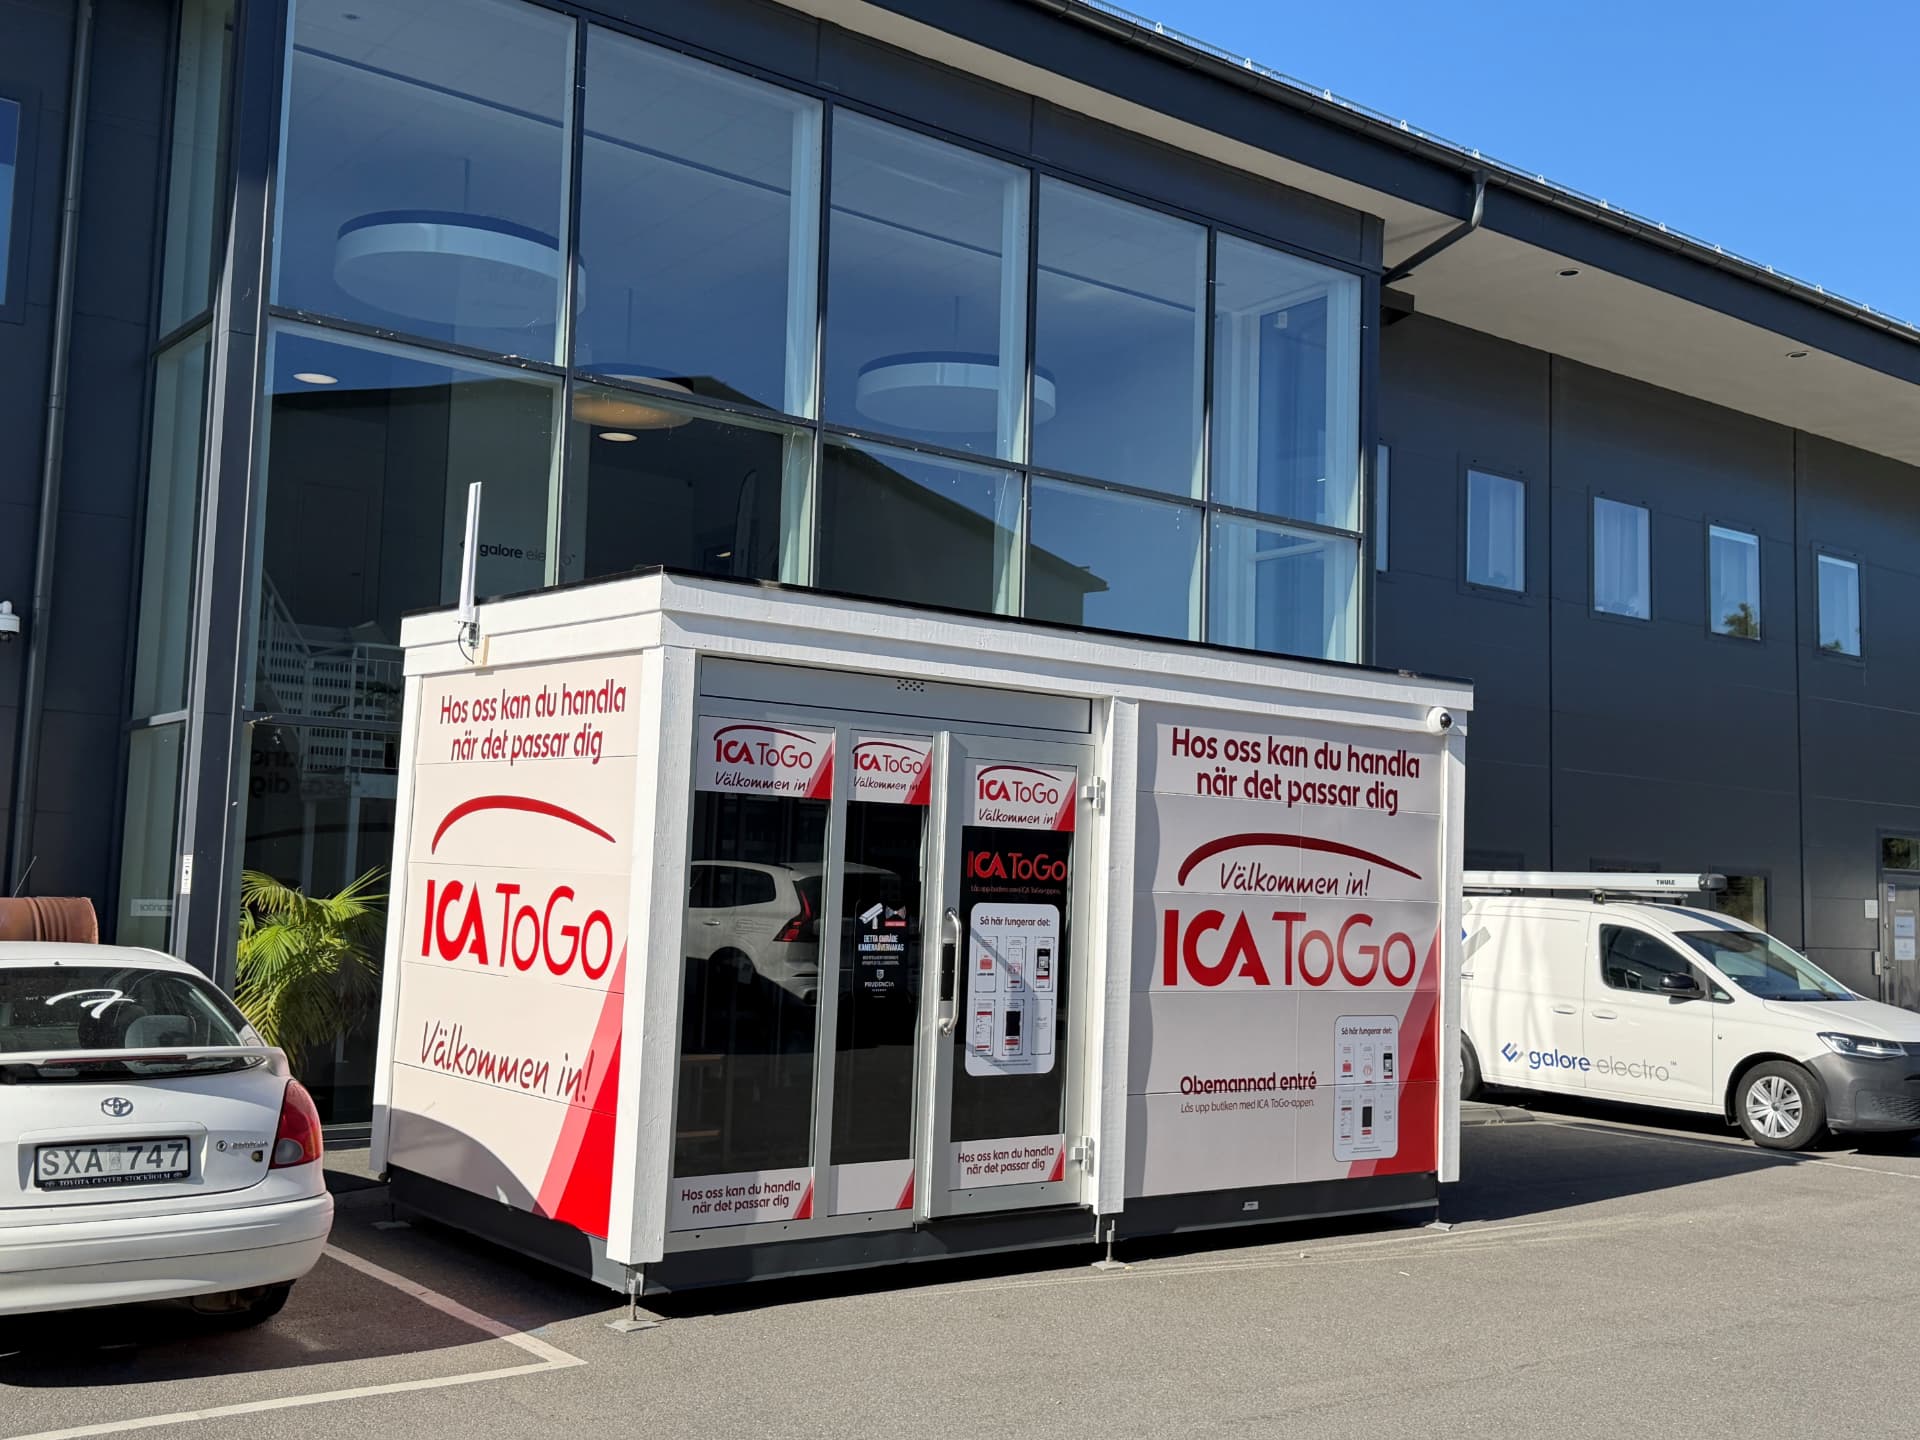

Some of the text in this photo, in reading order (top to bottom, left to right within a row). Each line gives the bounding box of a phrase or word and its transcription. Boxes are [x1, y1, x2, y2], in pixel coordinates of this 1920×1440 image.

[480, 543, 523, 559] galore
[440, 678, 626, 724] Hos oss kan du handla
[451, 723, 603, 766] när det passar dig
[715, 739, 813, 769] ICA ToGo
[1171, 727, 1420, 779] Hos oss kan du handla
[853, 753, 923, 774] ICA ToGo
[714, 771, 811, 792] Välkommen in!
[853, 776, 906, 791] Välkommen
[979, 779, 1059, 804] ICA ToGo
[1197, 766, 1398, 816] när det passar dig
[978, 808, 1058, 825] Välkommen in!
[967, 850, 1067, 881] ICA ToGo
[1220, 861, 1371, 896] Välkommen in!
[421, 879, 613, 980] ICA ToGo
[980, 916, 1050, 927] Så här fungerar det:
[1163, 909, 1416, 987] ICA ToGo
[421, 1020, 594, 1102] Välkommen in!
[1528, 1049, 1590, 1071] galore
[1596, 1056, 1669, 1082] electro
[1180, 1071, 1317, 1095] Obemannad entré
[1180, 1102, 1193, 1113] Lås
[1195, 1104, 1210, 1114] upp
[1211, 1101, 1238, 1112] butiken
[1240, 1099, 1255, 1110] med
[1257, 1099, 1269, 1109] ICA
[42, 1143, 183, 1176] SXA 747
[958, 1145, 1054, 1163] Hos oss kan du handla
[966, 1159, 1045, 1175] när det passar dig
[60, 1172, 171, 1187] TOYOTA CENTER STOCKHOLM
[681, 1180, 801, 1201] Hos oss kan du handla
[692, 1195, 789, 1215] när det passar dig
